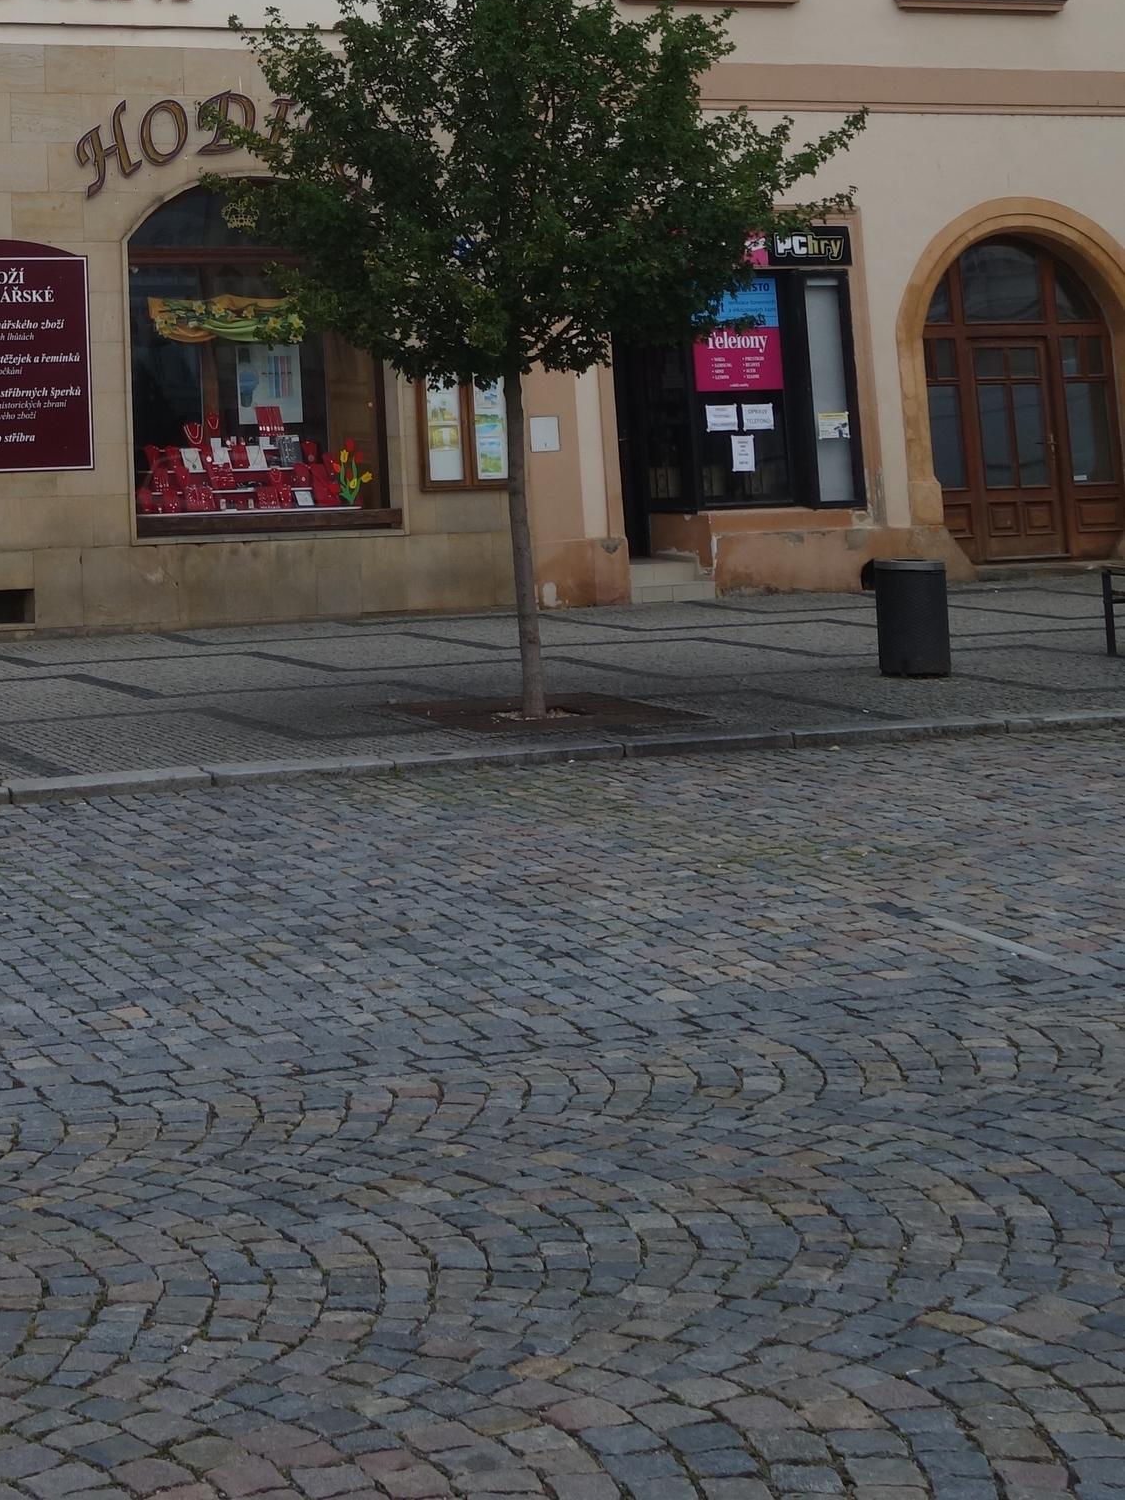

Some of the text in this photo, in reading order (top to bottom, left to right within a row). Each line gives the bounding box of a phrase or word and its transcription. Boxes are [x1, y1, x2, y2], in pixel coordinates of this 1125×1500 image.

[40, 318, 65, 330] zboží
[0, 387, 48, 400] stříbrných
[50, 385, 81, 399] šperků
[17, 411, 36, 420] zboží
[4, 432, 36, 443] stříbra
